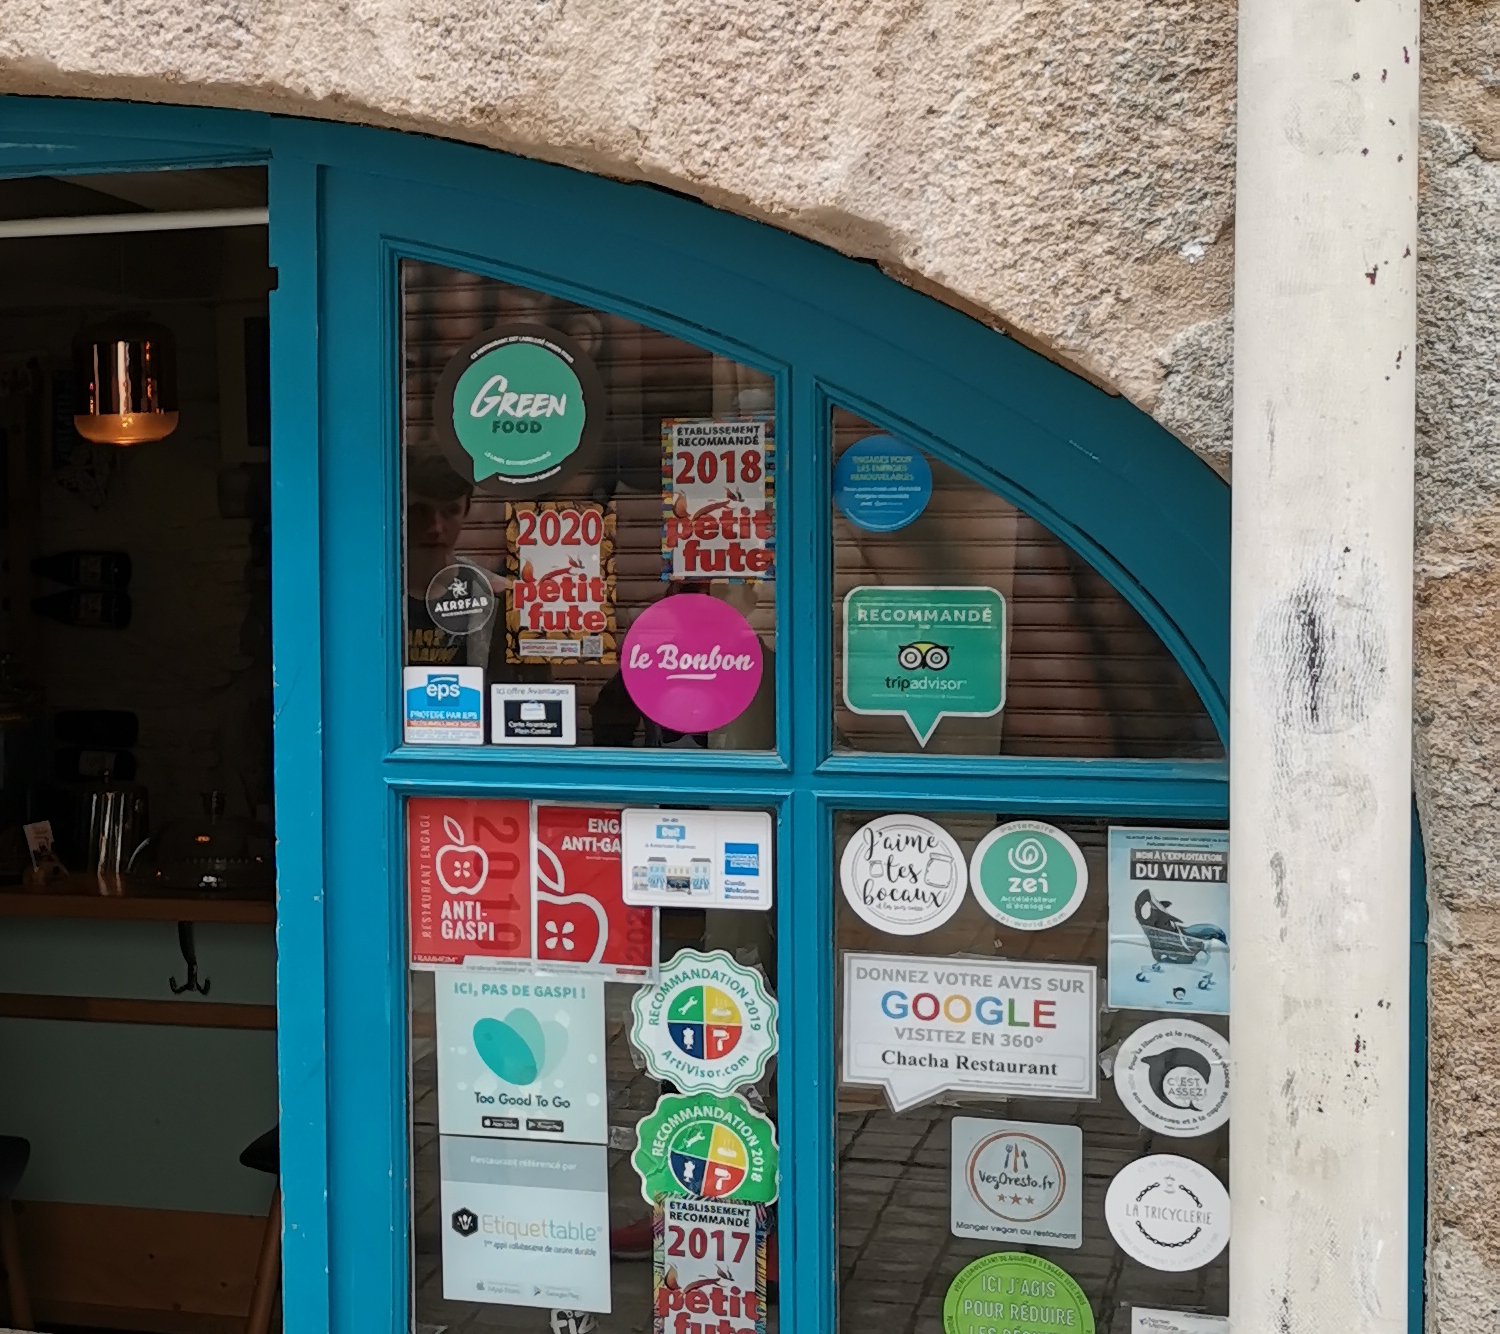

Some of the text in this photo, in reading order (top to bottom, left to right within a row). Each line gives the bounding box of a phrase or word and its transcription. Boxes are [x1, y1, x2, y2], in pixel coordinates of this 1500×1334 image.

[492, 420, 542, 433] FOOD
[678, 434, 759, 446] RECOMMANDÉ
[676, 450, 762, 484] 2018
[517, 511, 602, 546] 2020
[666, 507, 774, 547] petit
[513, 574, 605, 608] petit
[434, 597, 488, 613] AEROFAB
[858, 608, 992, 622] RECOMMANDÉ
[630, 644, 754, 671] le Bonbon
[426, 684, 460, 701] eps
[527, 687, 569, 696] Avantages
[885, 676, 963, 691] tripadvisor
[588, 818, 621, 834] ENG
[561, 836, 621, 852] ANTI-GA
[886, 854, 922, 884] tes
[1136, 863, 1223, 880] DU VIVANT
[863, 879, 947, 907] bocaux
[1008, 872, 1048, 893] zei
[420, 870, 432, 938] RESTAURANT
[441, 901, 487, 921] ANTI-
[441, 921, 495, 941] GASPI
[454, 982, 586, 999] ICI, PAS DE GASPI !
[856, 967, 1085, 993] DONNEZ VOTRE AVIS SUR
[649, 968, 761, 1032] RECOMMANDATION 2019
[881, 990, 1056, 1029] GOOGLE
[894, 1027, 1043, 1048] VISITEZ EN 360°
[882, 1050, 1058, 1075] Chacha Restaurant
[1167, 1077, 1200, 1086] C'EST
[475, 1092, 570, 1108] Too Good To Go
[651, 1105, 763, 1183] RECOMMANDATION 2018
[470, 1155, 518, 1167] Restaurant
[978, 1170, 1055, 1190] VegOresto.fr
[670, 1212, 749, 1227] RECOMMANDÉ
[1126, 1204, 1212, 1225] LA TRICYCLERIE
[956, 1221, 988, 1232] Manger
[991, 1225, 1018, 1234] vegan
[668, 1225, 750, 1263] 2017
[982, 1275, 1056, 1298] ICI J'AGIS
[658, 1286, 761, 1320] petit
[964, 1300, 1075, 1326] POUR RÉDUIRE
